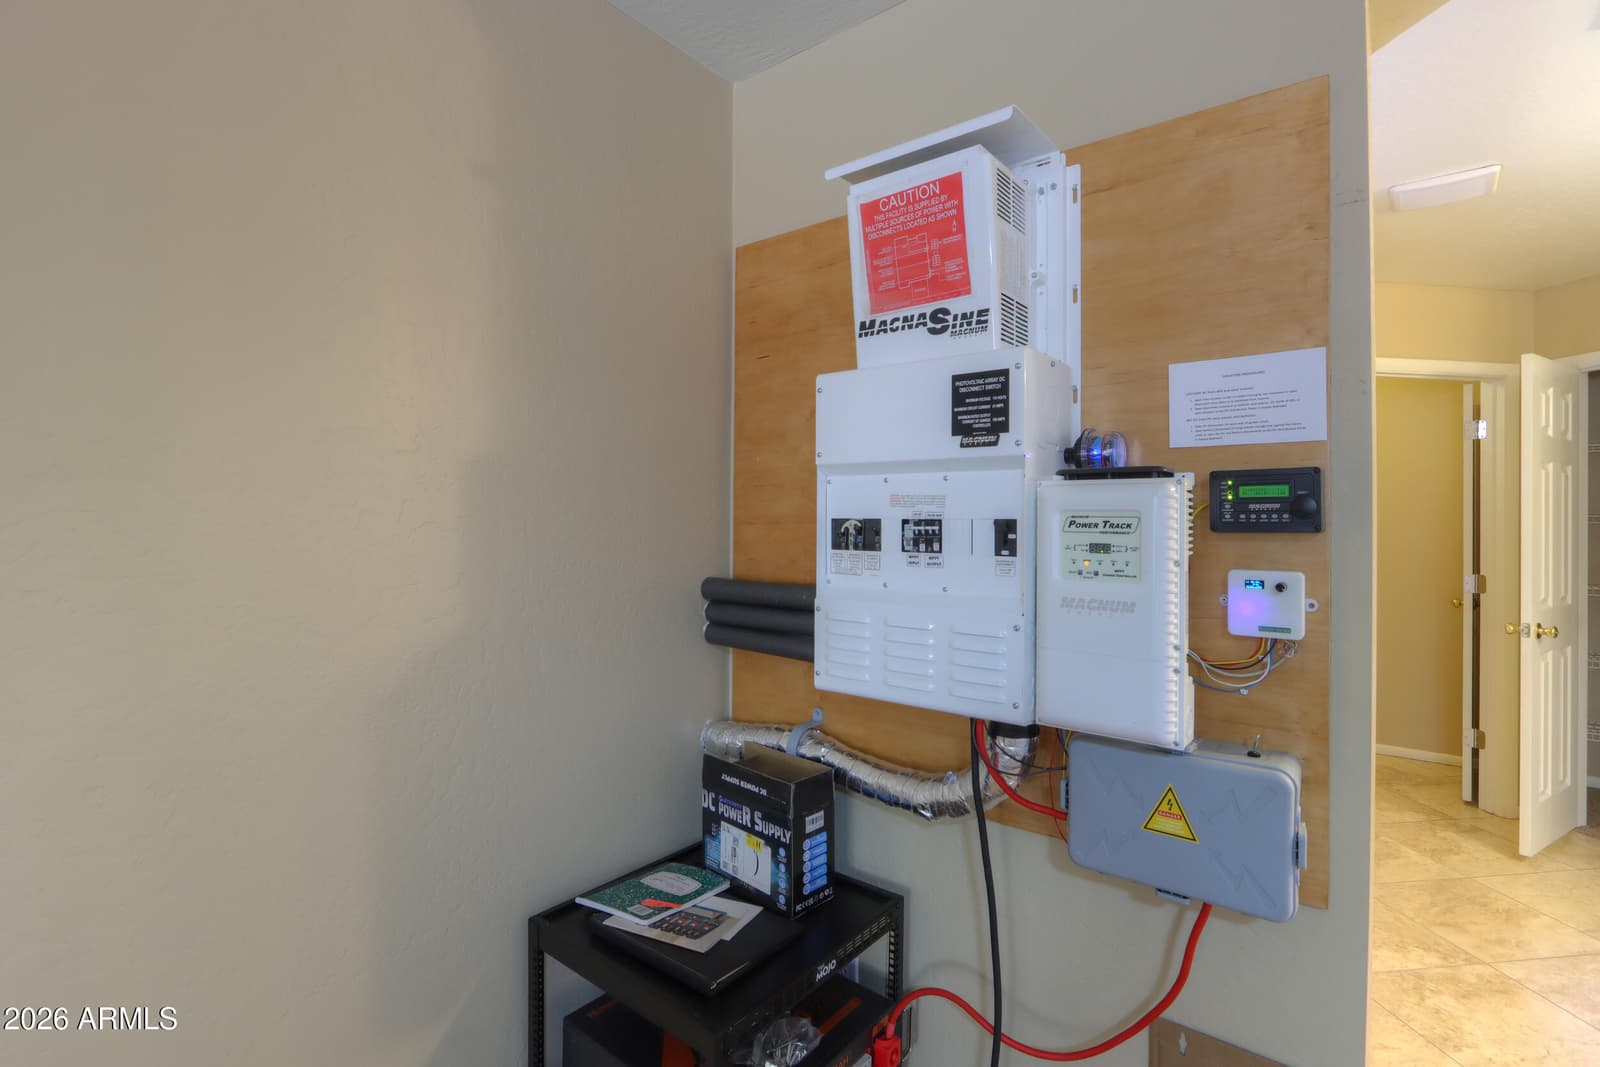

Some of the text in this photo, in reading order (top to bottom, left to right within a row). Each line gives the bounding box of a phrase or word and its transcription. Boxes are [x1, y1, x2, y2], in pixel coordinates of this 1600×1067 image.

[874, 214, 886, 223] THIS
[885, 207, 907, 220] FACILITY
[914, 197, 940, 210] SUPPLIED
[940, 194, 949, 203] BY
[879, 181, 940, 211] CAUTION
[865, 220, 889, 232] MULTIPLE
[889, 213, 915, 227] SOURCES
[923, 205, 944, 217] POWER
[944, 199, 959, 210] WITH
[867, 209, 957, 240] DISCONNECTS LOCATED AS SHOWN
[1068, 519, 1133, 530] POWER TRACK
[721, 773, 739, 786] SUPPLY
[740, 780, 759, 793] POWER
[702, 788, 716, 812] DC
[754, 810, 792, 844] SUPPLY
[815, 959, 837, 983] MOJO
